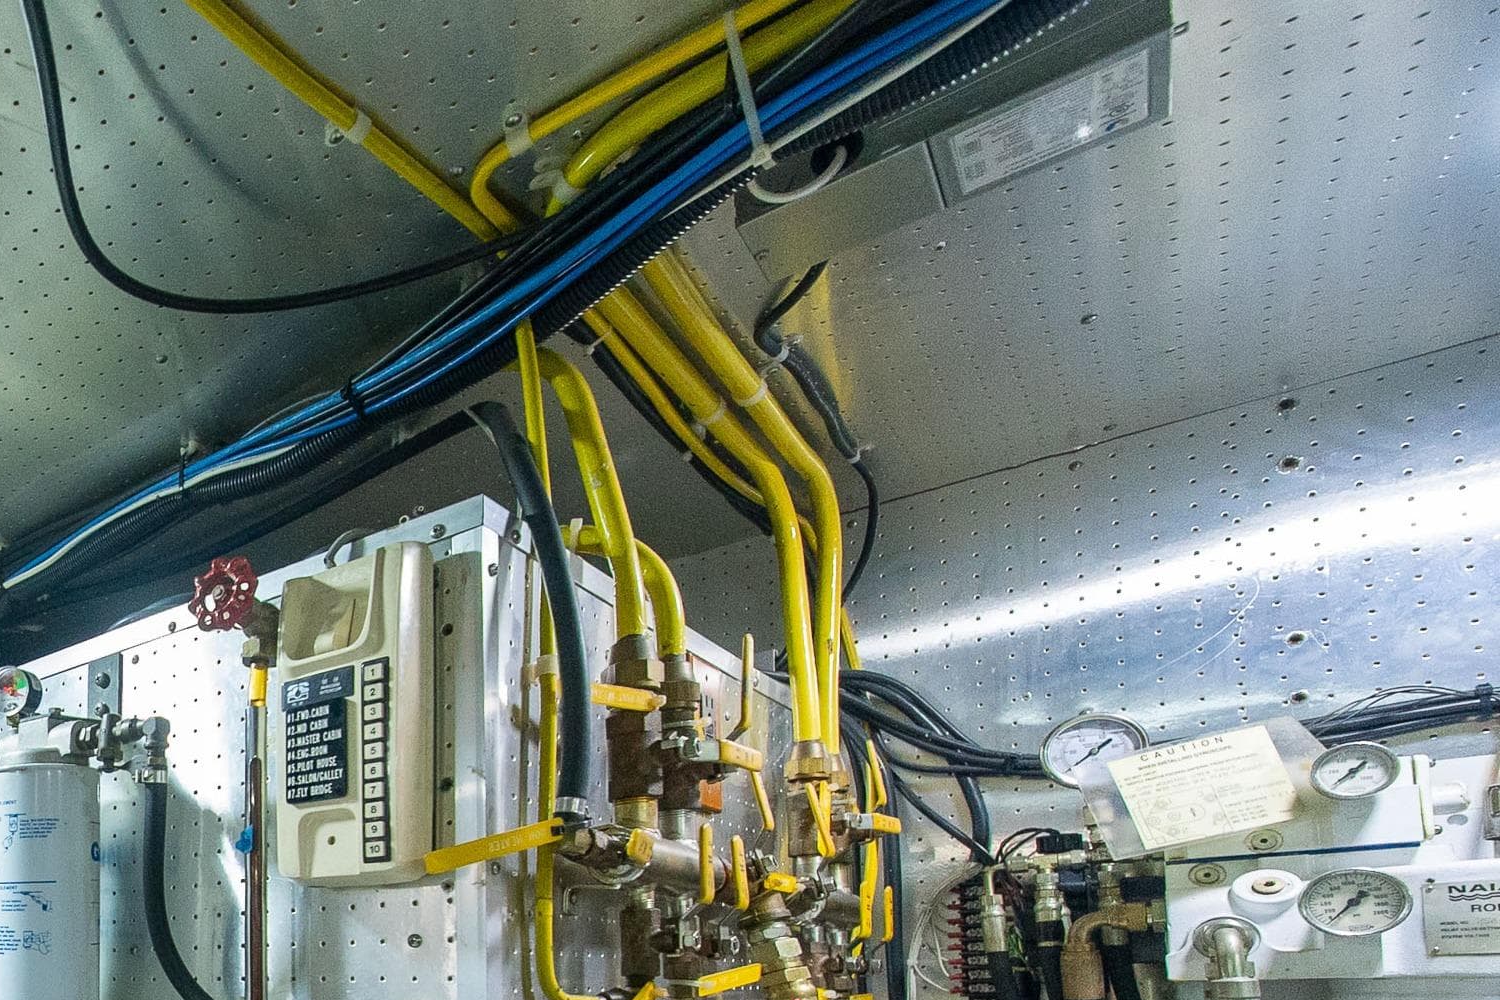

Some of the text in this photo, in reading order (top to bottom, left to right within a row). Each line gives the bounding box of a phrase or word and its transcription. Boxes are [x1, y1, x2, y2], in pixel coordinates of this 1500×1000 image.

[371, 669, 376, 677] 1
[370, 687, 376, 697] 2
[370, 707, 376, 716] 3
[309, 718, 329, 731] CABIN
[322, 728, 343, 742] CABIN
[370, 727, 377, 736] 4
[371, 747, 377, 756] 5
[1140, 735, 1225, 762] CAUTION
[316, 755, 338, 769] HOUSE
[371, 766, 377, 775] 6
[310, 782, 333, 796] BRIDGE
[371, 786, 377, 795] 7
[371, 805, 378, 814] 8
[371, 825, 378, 834] 9
[370, 845, 380, 854] 10
